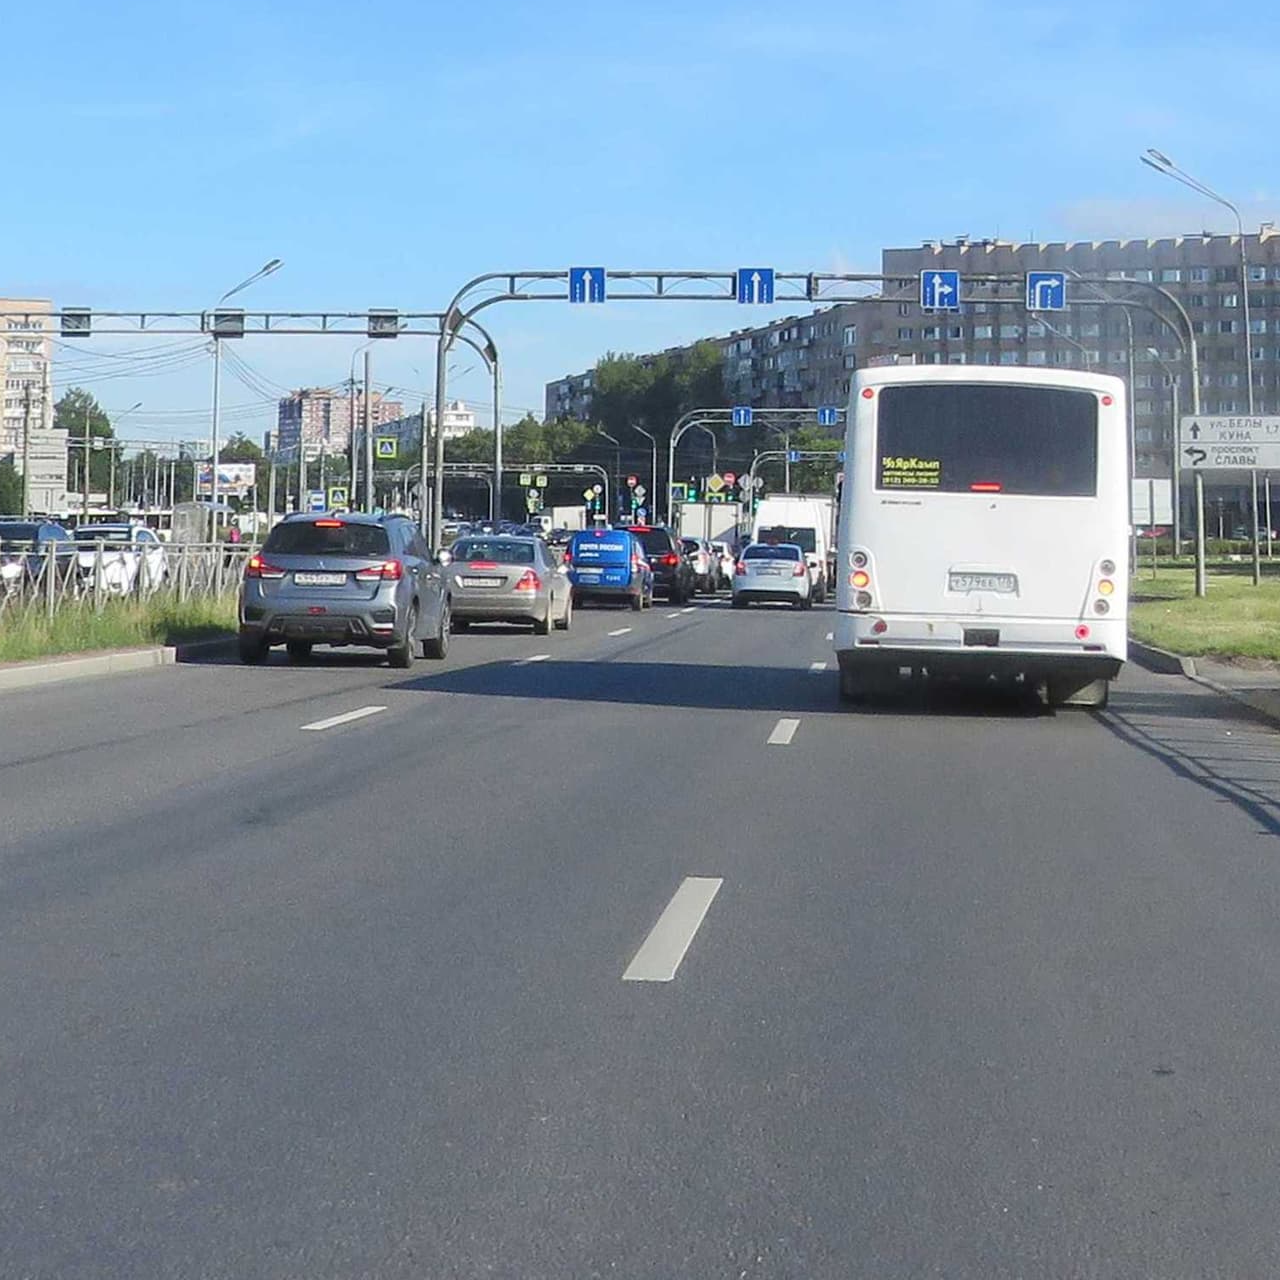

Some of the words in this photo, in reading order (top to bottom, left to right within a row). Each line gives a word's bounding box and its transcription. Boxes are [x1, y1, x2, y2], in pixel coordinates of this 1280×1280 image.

[1228, 418, 1262, 429] БЕЛЫ
[1219, 430, 1252, 441] КУНА
[1215, 455, 1257, 465] СЛАВЫ
